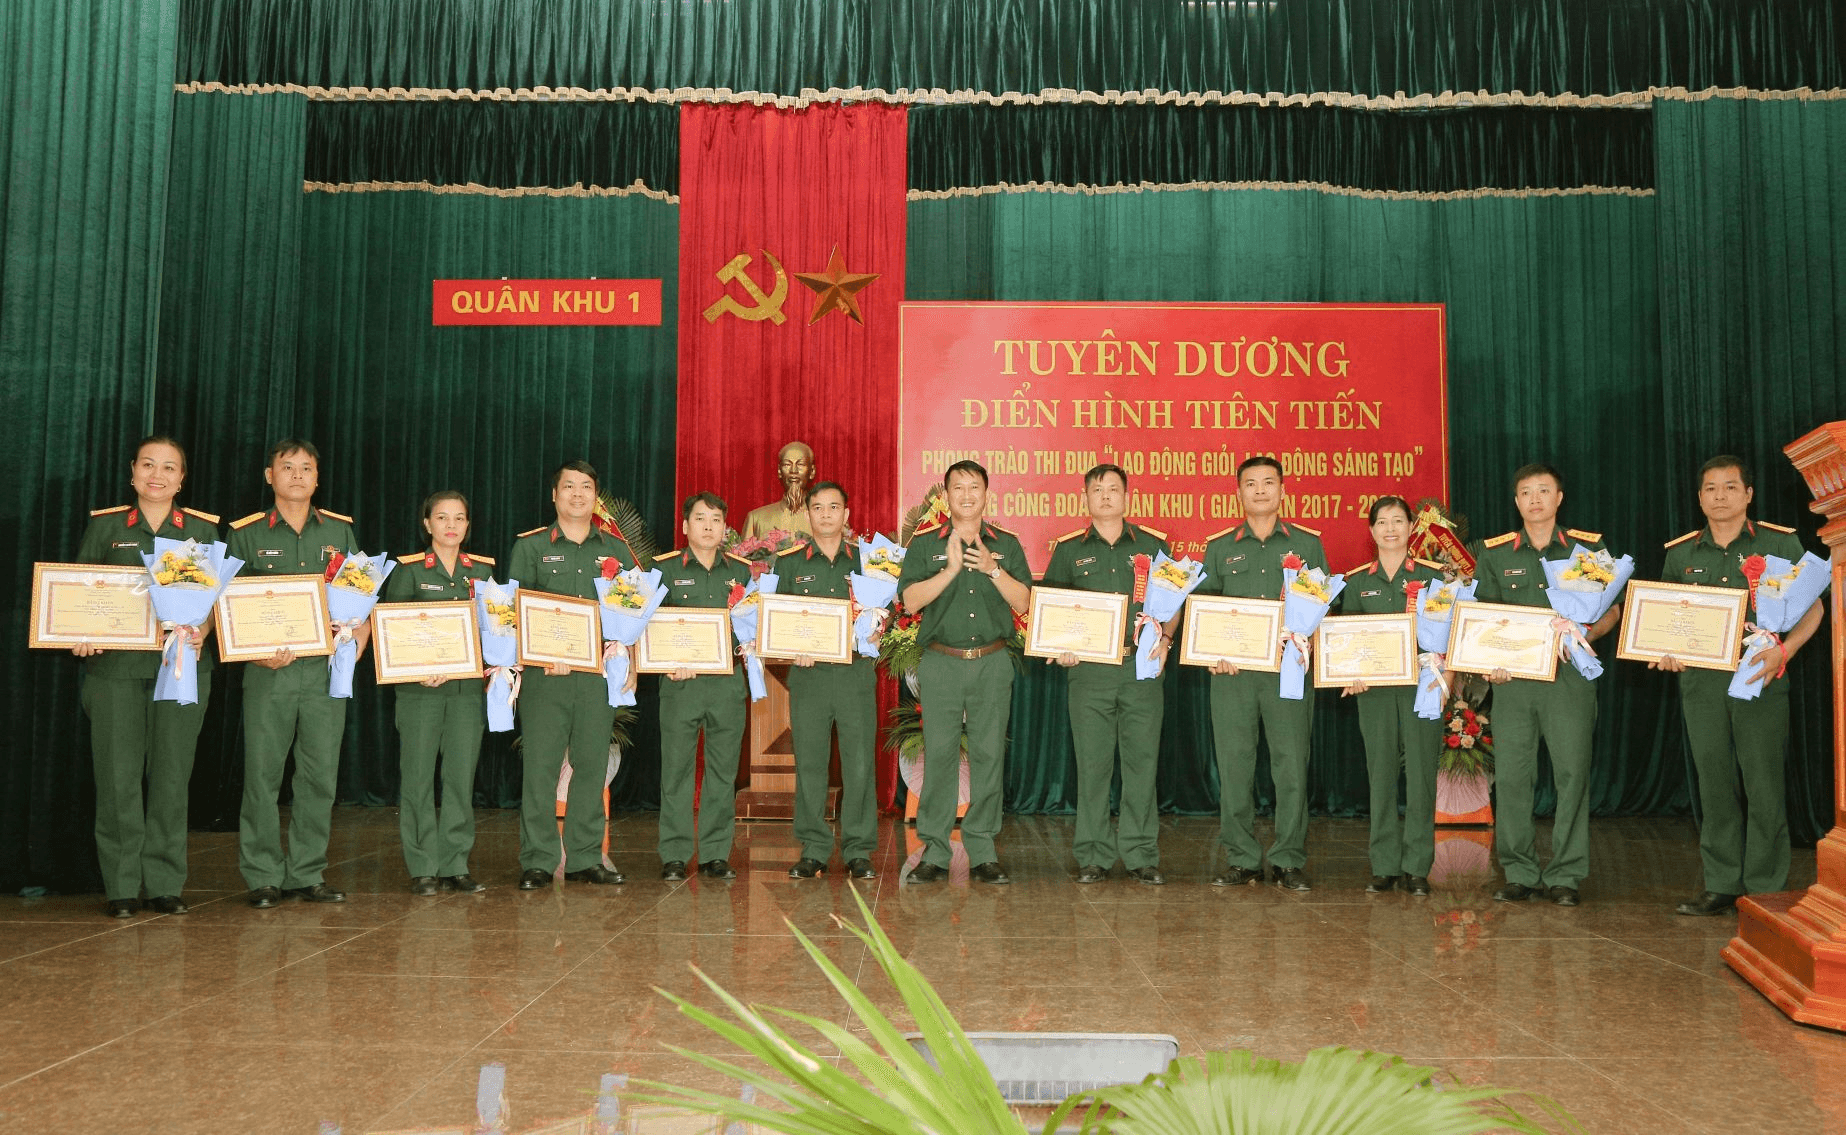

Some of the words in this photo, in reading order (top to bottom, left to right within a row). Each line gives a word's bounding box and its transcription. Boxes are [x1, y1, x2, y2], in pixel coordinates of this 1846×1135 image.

[451, 285, 540, 314] QUÂN
[552, 290, 615, 314] KHU
[627, 291, 640, 313] 1
[993, 328, 1161, 376] TUYÊN
[1173, 335, 1351, 378] DƯƠNG
[960, 381, 1062, 428] ĐIỂN
[1071, 390, 1175, 429] HÌNH
[1185, 391, 1280, 430] TIÊN
[1289, 387, 1383, 430] TIẾN
[984, 445, 1030, 475] TRÀO
[1033, 450, 1060, 475] THI
[1065, 450, 1098, 475] ĐUA
[1149, 446, 1197, 481] ĐỘNG
[1281, 447, 1328, 482] ĐỘNG
[1332, 447, 1379, 477] SÁNG
[1382, 445, 1424, 482] TẠO”
[1002, 488, 1051, 518] CÔNG
[1054, 487, 1091, 518] ĐOÀ
[1122, 488, 1155, 518] ÂN
[1159, 493, 1194, 518] KHU
[1301, 494, 1342, 519] 2017
[1187, 540, 1208, 553] thá
